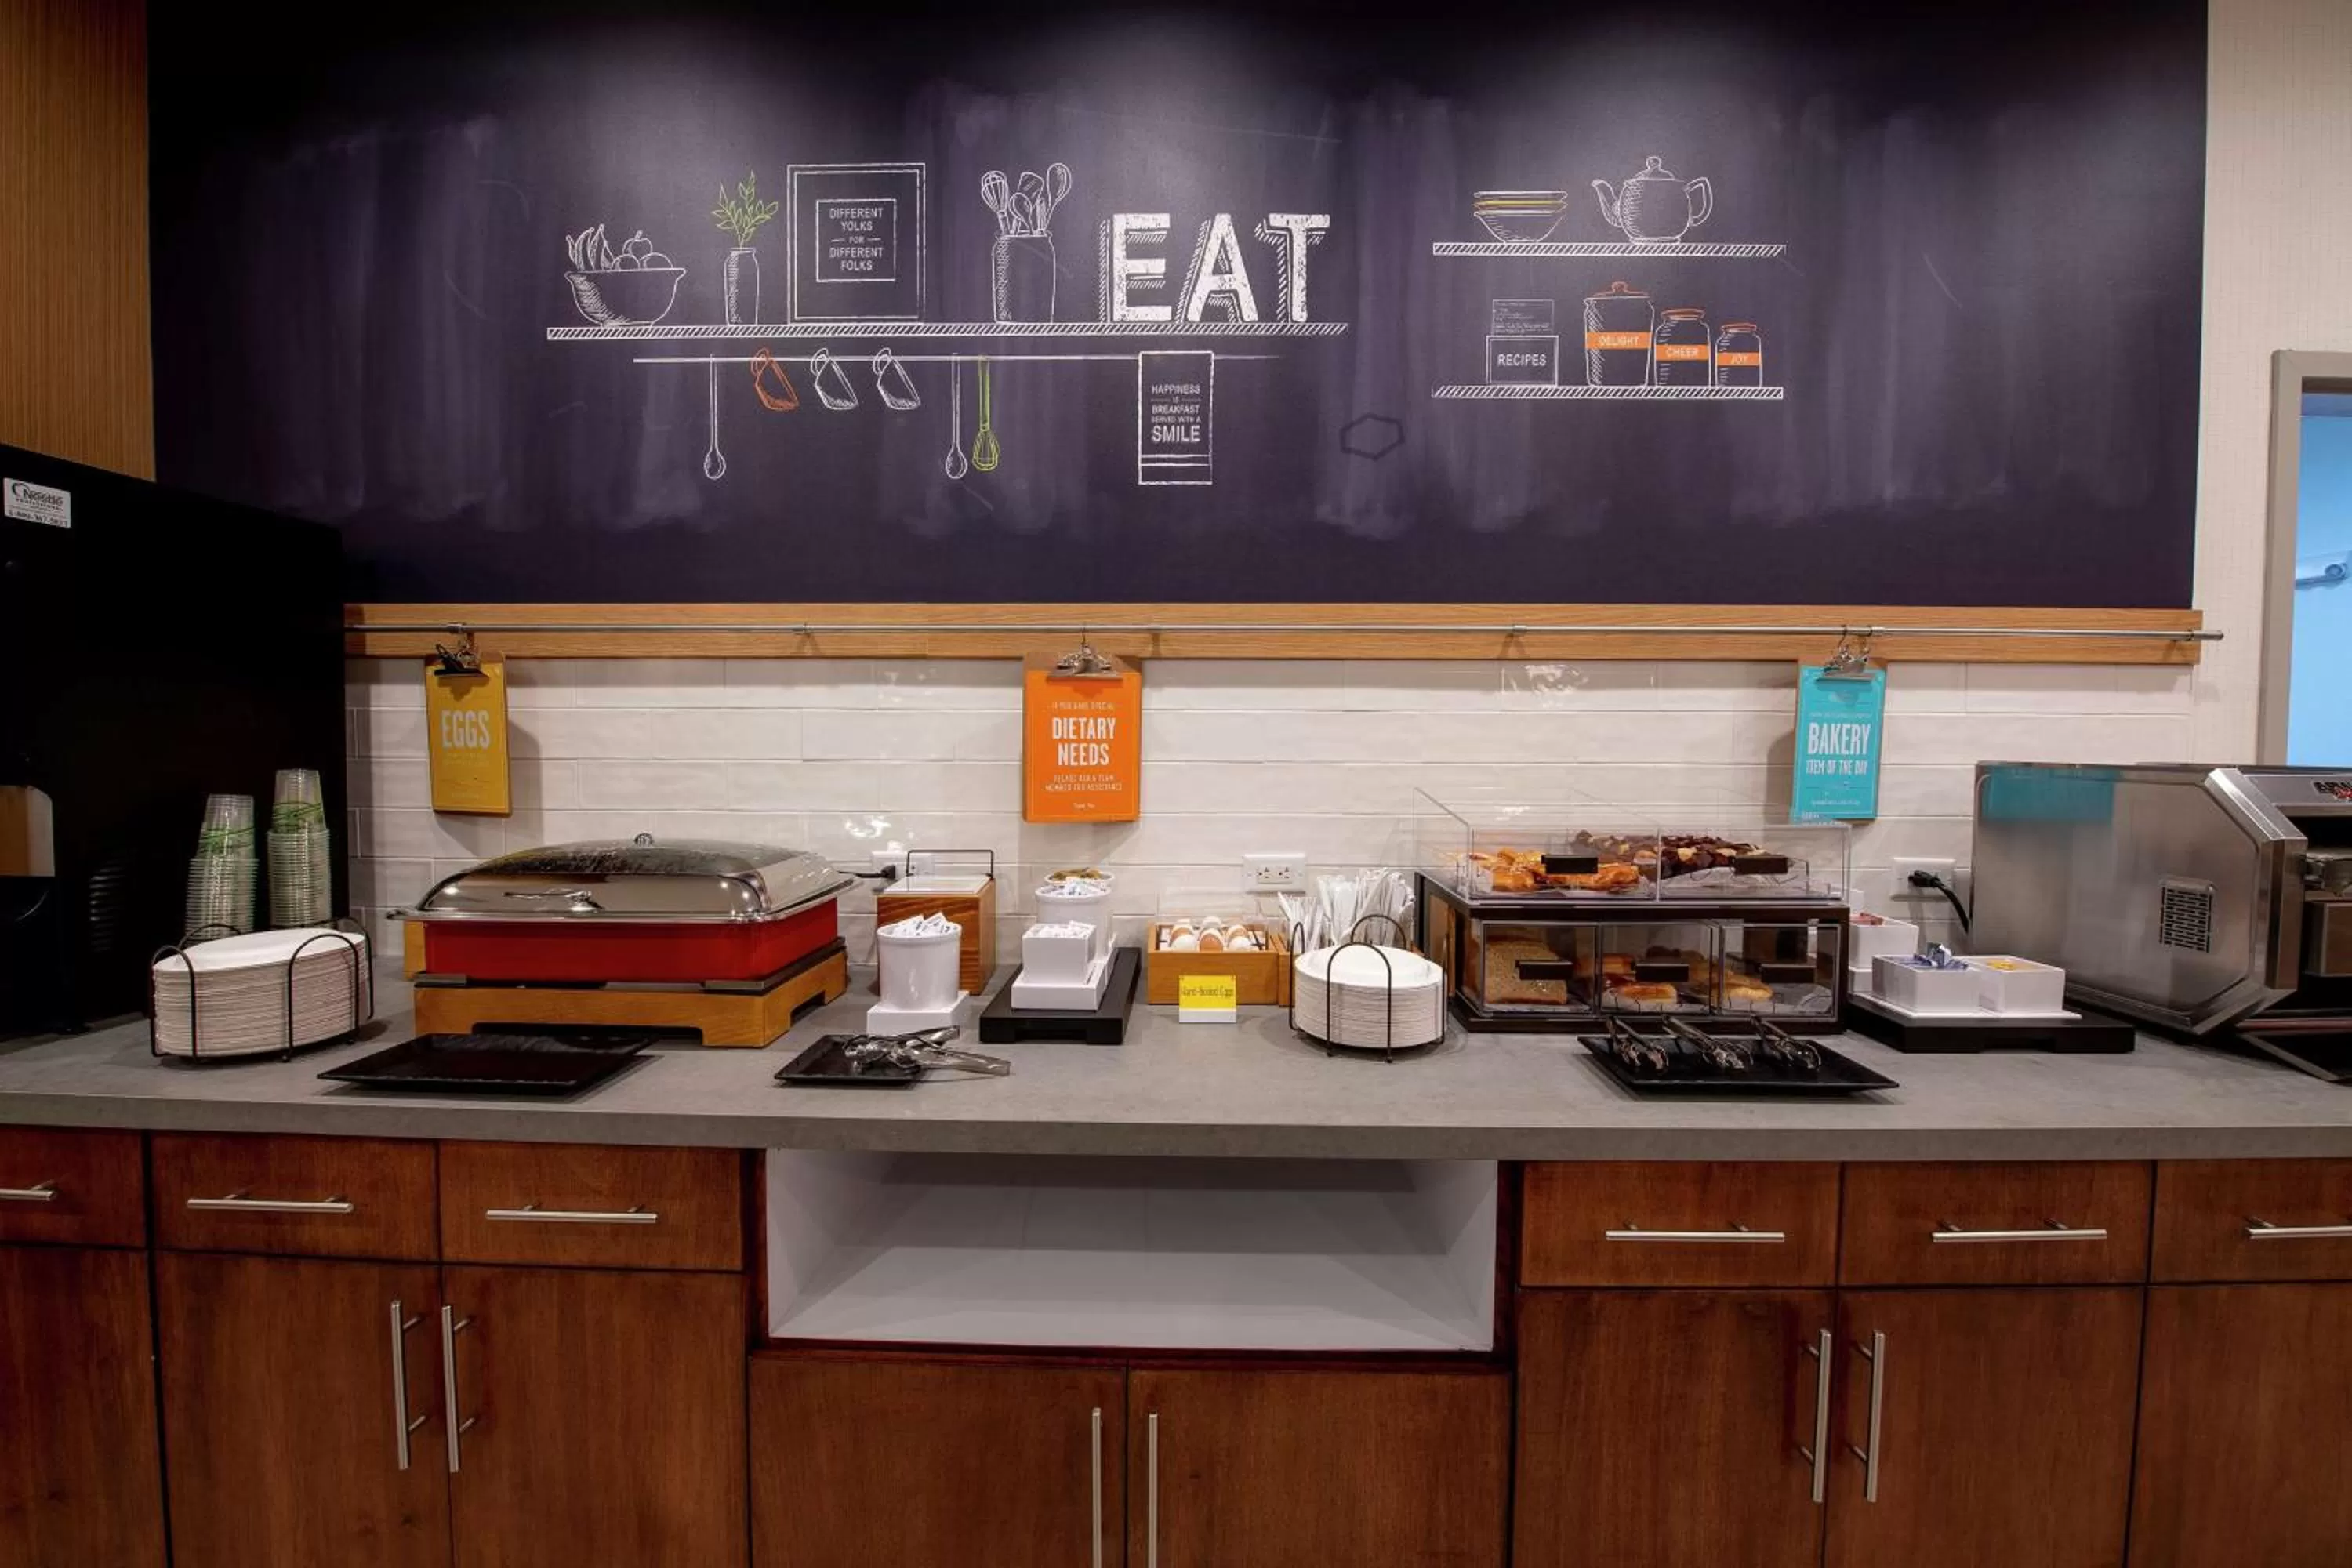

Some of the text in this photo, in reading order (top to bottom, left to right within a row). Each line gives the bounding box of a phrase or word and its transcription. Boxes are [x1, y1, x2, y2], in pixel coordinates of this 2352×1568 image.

[829, 207, 884, 219] DIFFERENT
[840, 220, 873, 232] YOLKS
[829, 247, 884, 258] DIFFERENT
[840, 260, 873, 271] FOLKS
[1111, 212, 1331, 322] EAT
[1598, 336, 1639, 347] DELIGHT
[1665, 346, 1700, 358] CHEER
[1497, 353, 1547, 367] RECIPES
[1730, 354, 1748, 365] JOY
[1151, 383, 1201, 394] HAPPINESS
[1151, 404, 1200, 415] BREAKFAST
[1151, 424, 1201, 444] SMILE
[441, 709, 491, 750] EGGS
[1051, 716, 1117, 740] DIETARY
[1807, 721, 1871, 756] BAKERY
[1057, 742, 1110, 766] NEEDS
[1806, 758, 1868, 775] ITEM OF THE DAY
